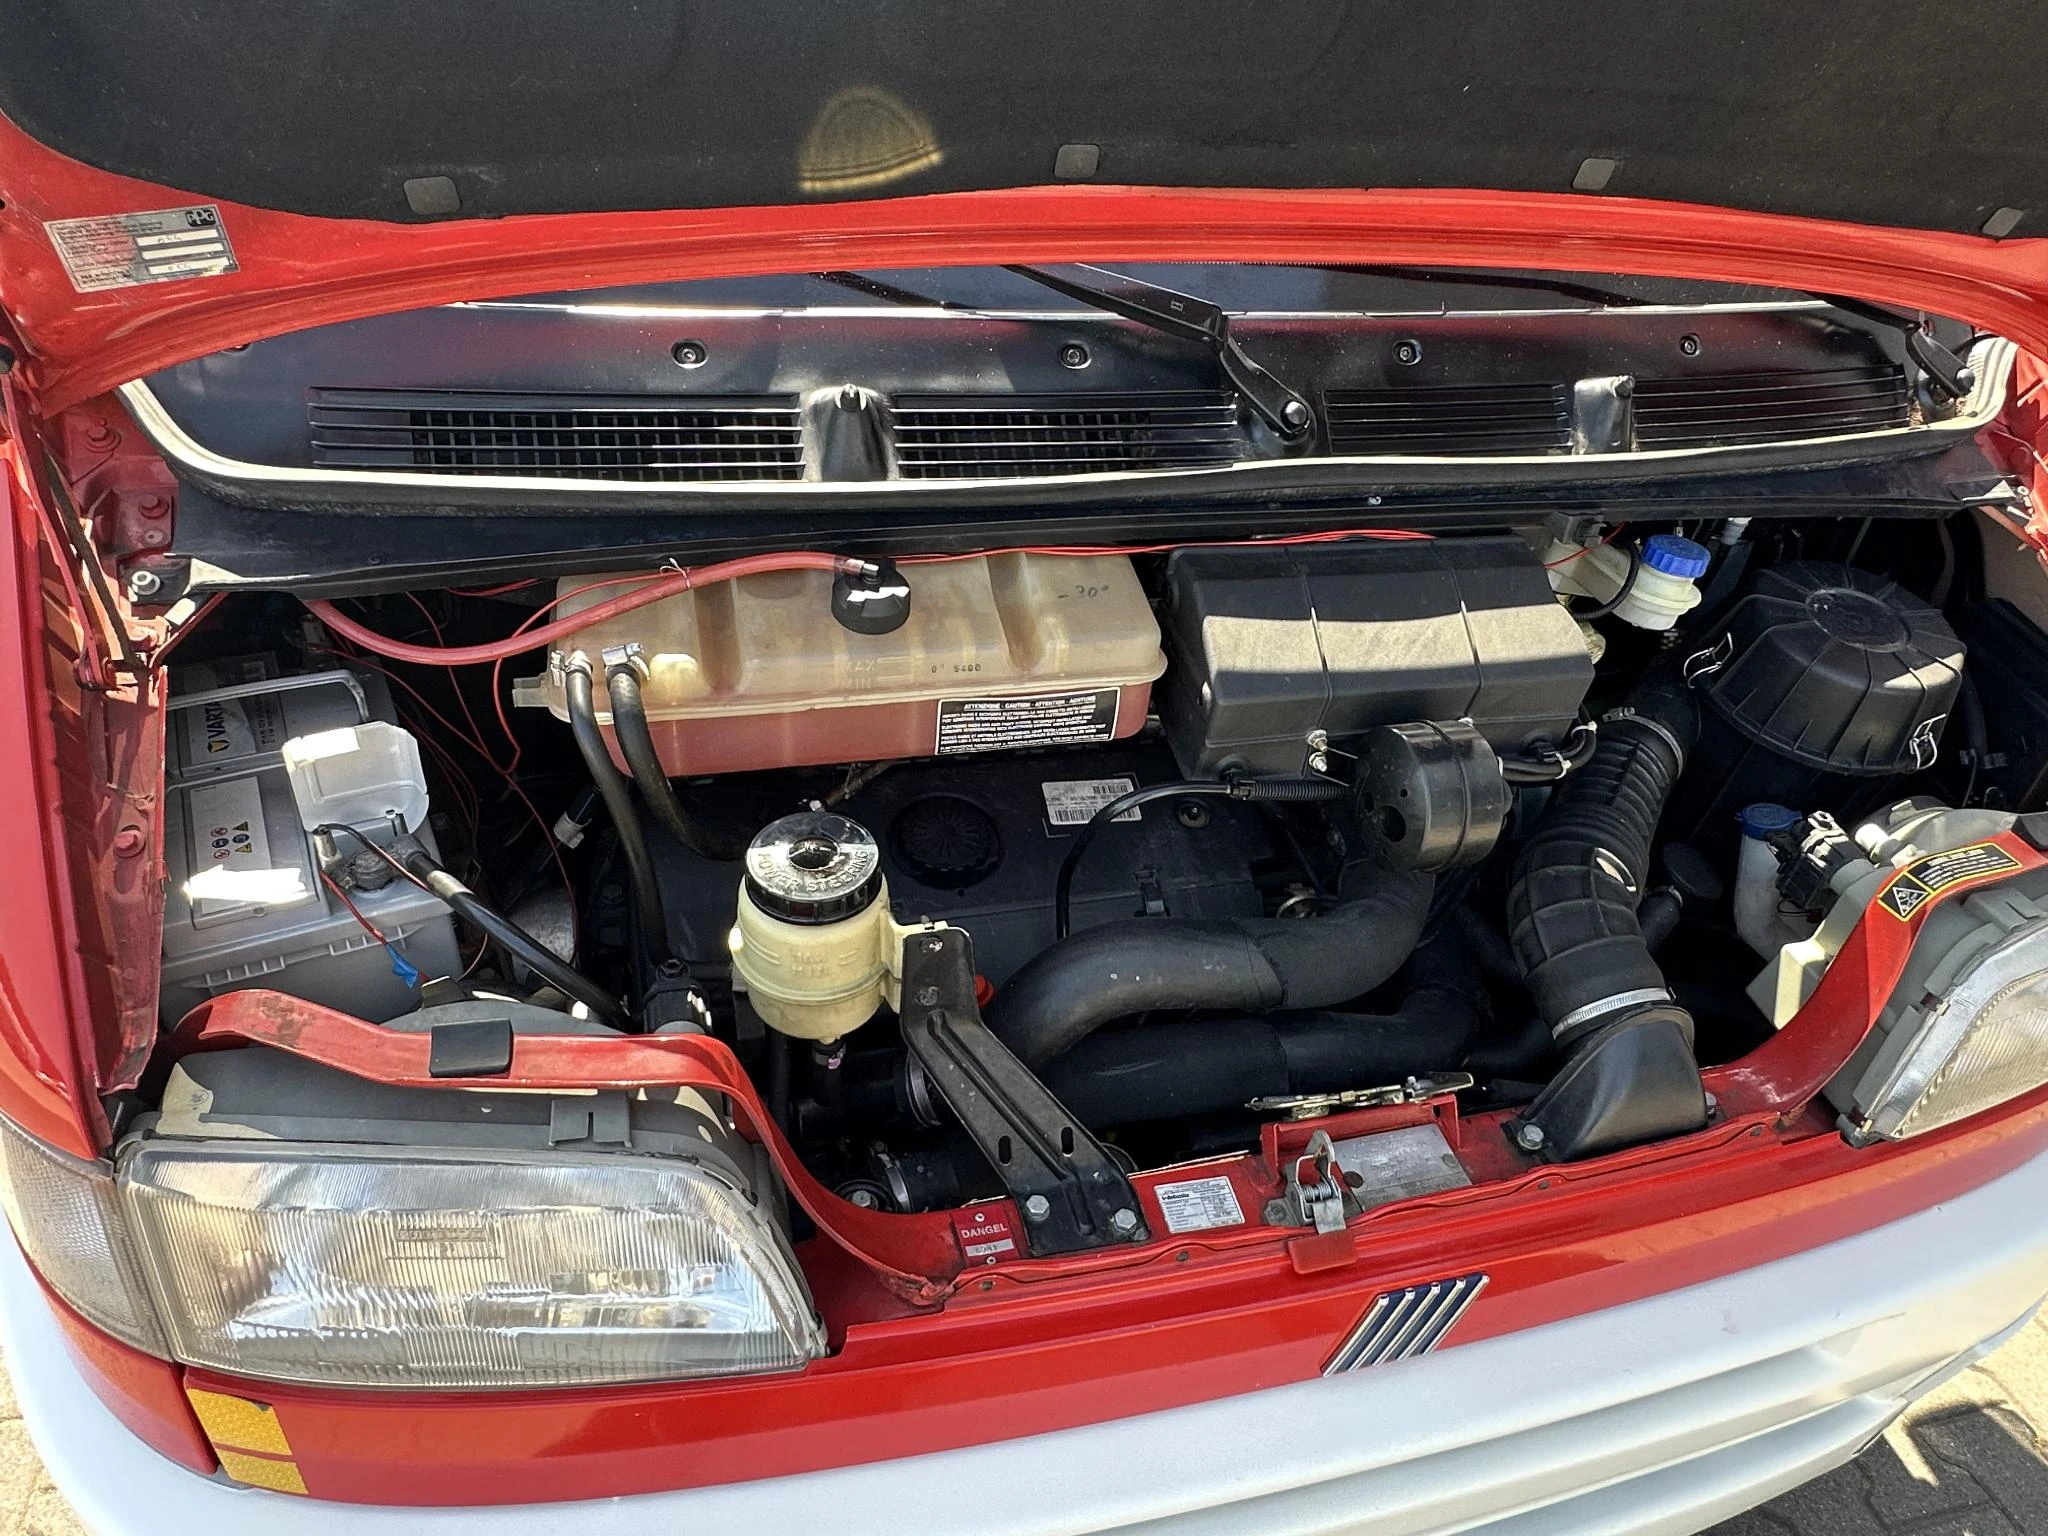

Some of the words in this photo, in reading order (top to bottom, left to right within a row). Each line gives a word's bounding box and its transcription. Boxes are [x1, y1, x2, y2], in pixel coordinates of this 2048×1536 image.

[187, 210, 215, 225] PPG
[758, 853, 802, 892] POWER
[806, 850, 869, 892] STEERING
[960, 1223, 1008, 1238] DANGEL
